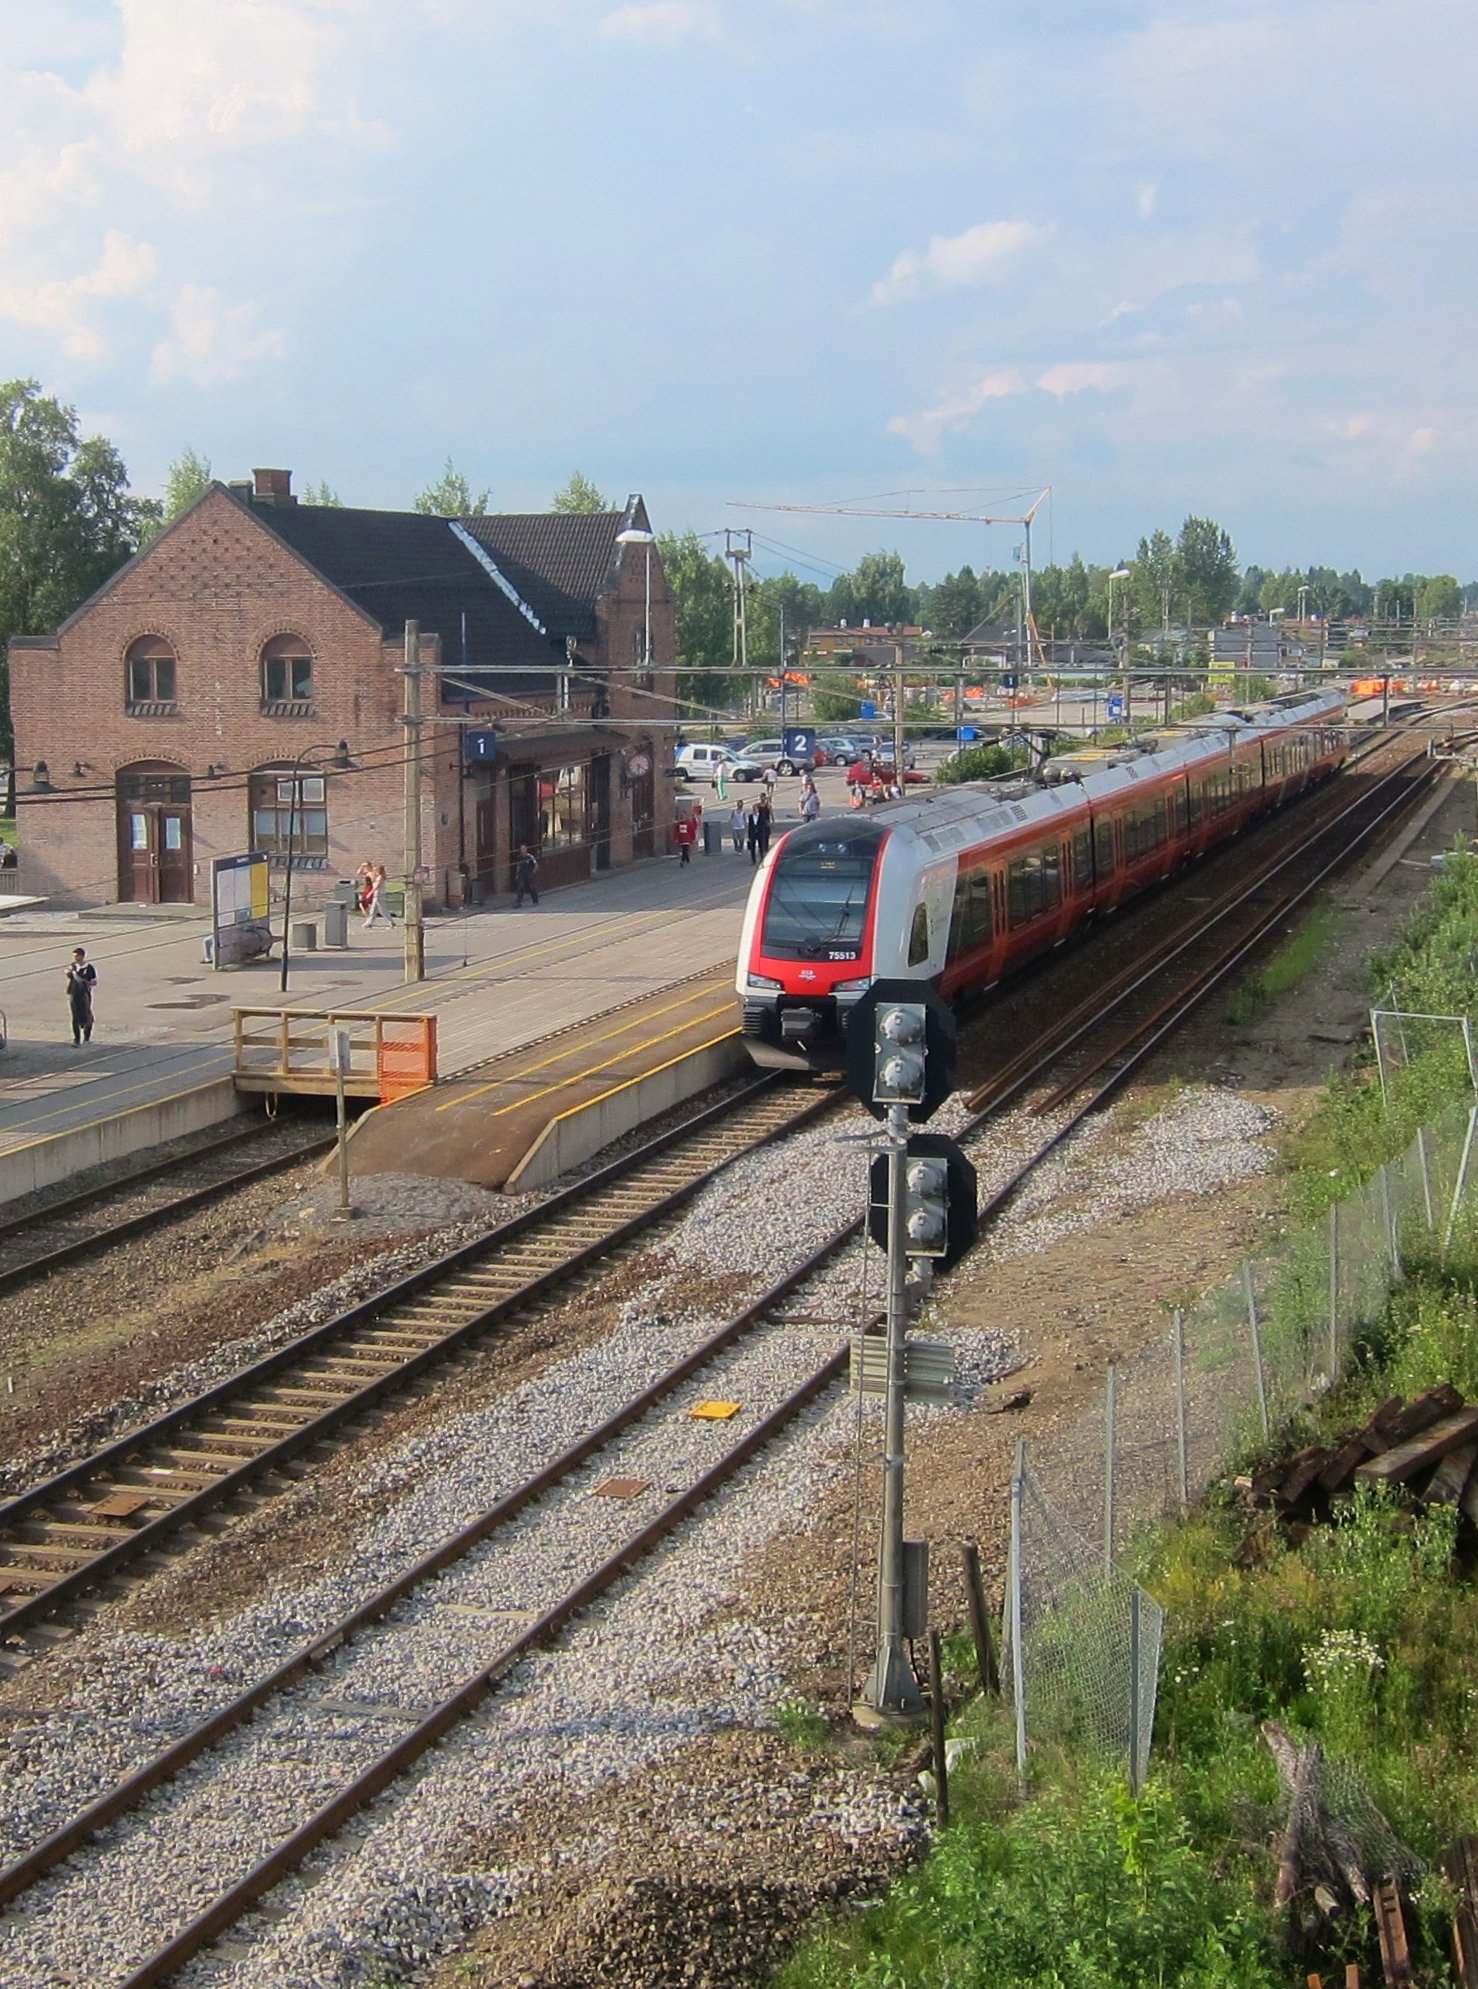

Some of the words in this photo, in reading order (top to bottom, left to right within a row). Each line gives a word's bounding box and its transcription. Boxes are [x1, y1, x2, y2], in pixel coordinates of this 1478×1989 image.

[477, 738, 484, 754] 1
[795, 735, 806, 751] 2
[829, 951, 856, 960] 75513
